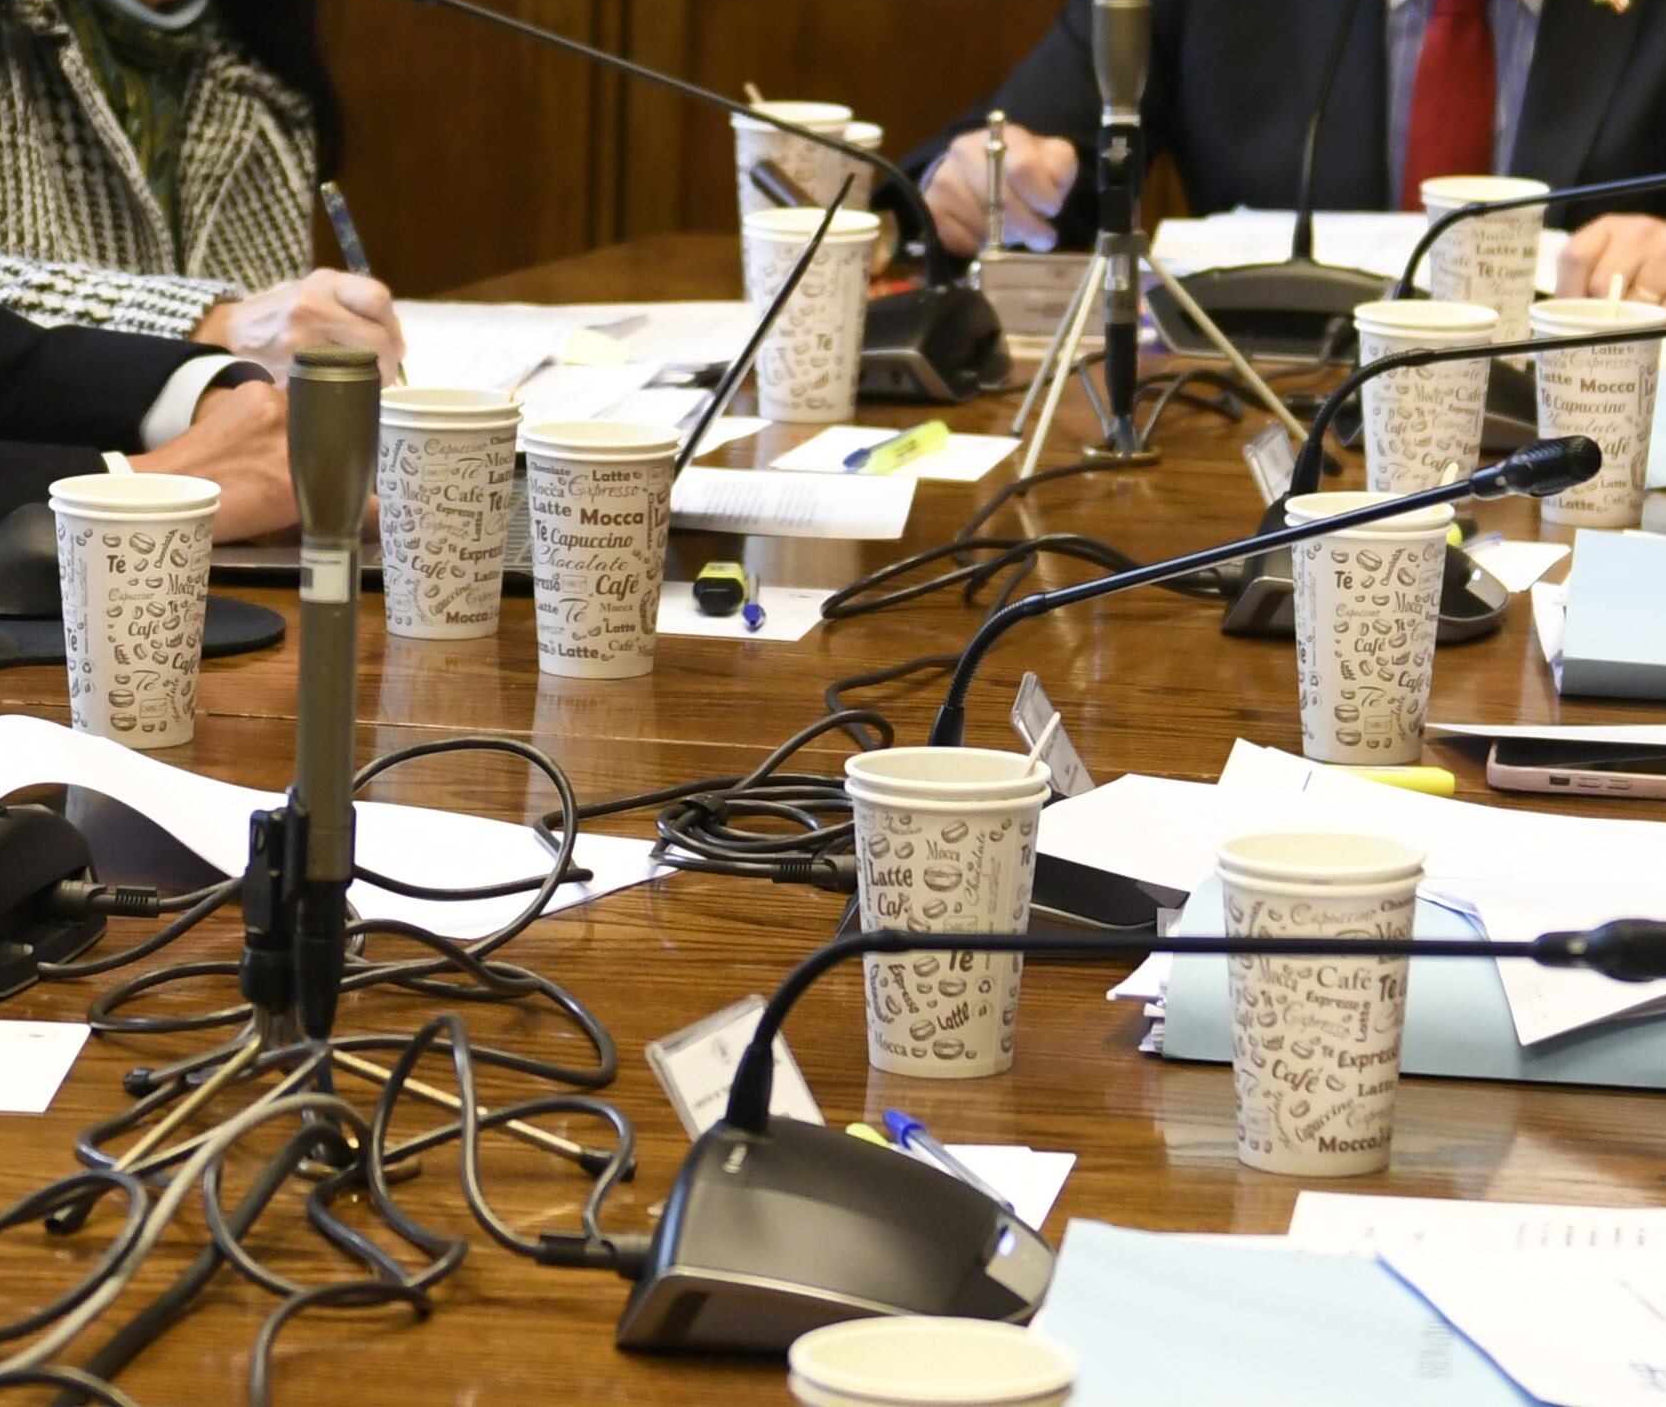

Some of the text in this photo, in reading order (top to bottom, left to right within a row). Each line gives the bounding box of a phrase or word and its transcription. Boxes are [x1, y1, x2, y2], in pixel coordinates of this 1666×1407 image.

[816, 333, 832, 351] Té
[1580, 378, 1636, 393] Mocca
[1554, 394, 1626, 414] Capuccino
[592, 469, 631, 482] Latte
[444, 484, 484, 503] Café
[1558, 496, 1595, 511] Latte
[532, 497, 572, 517] Latte
[580, 508, 644, 526] Mocca
[535, 520, 548, 542] Té
[551, 527, 633, 549] Capuccino
[107, 555, 126, 573] Té
[411, 555, 447, 580] Café
[595, 573, 638, 602] Café
[1334, 570, 1354, 590] Té
[445, 610, 488, 625] Mocca
[128, 619, 160, 640] Café
[559, 644, 599, 659] Latte
[1354, 637, 1386, 655] Café
[1398, 670, 1424, 694] Café
[870, 860, 913, 887] Latte
[1316, 965, 1372, 991] Café
[936, 1001, 970, 1031] Latte
[1271, 1058, 1323, 1094] Café
[1319, 1136, 1378, 1153] Mocca
